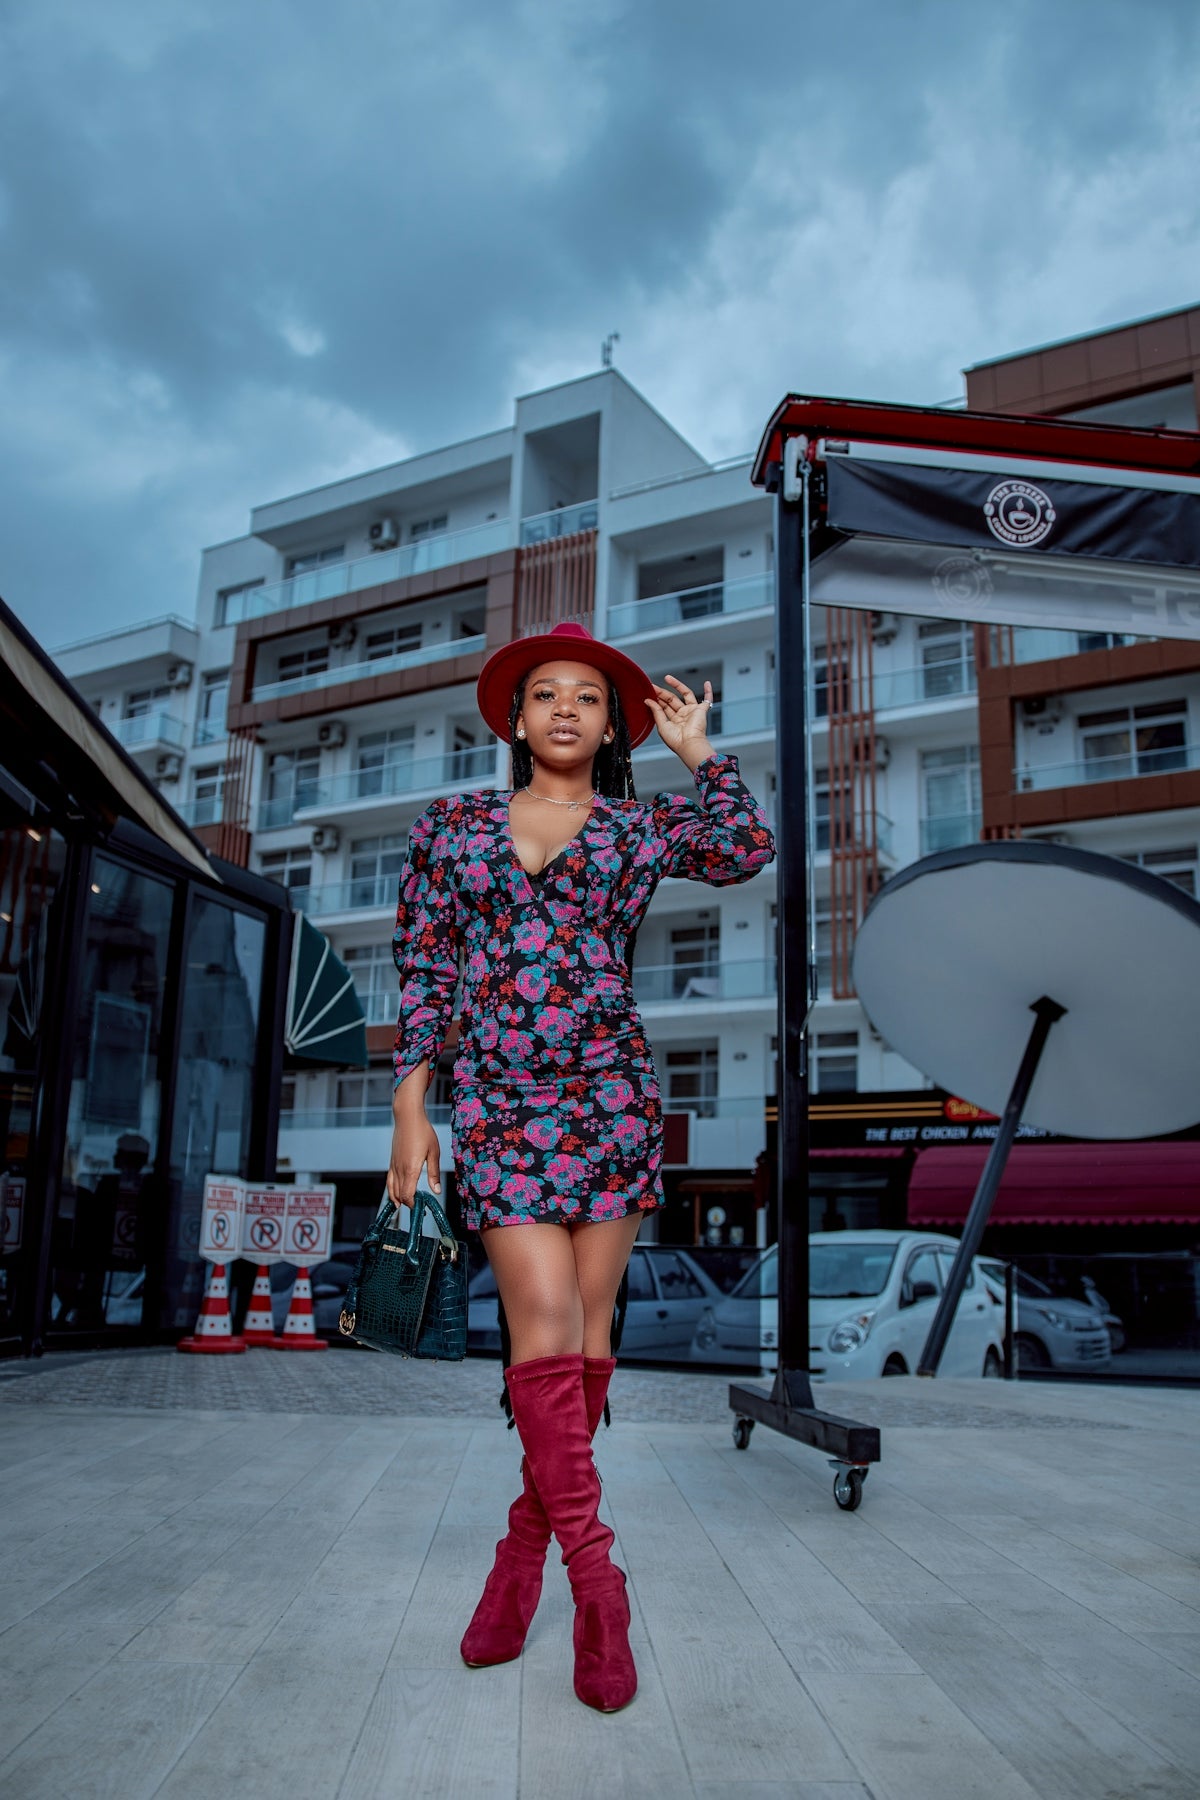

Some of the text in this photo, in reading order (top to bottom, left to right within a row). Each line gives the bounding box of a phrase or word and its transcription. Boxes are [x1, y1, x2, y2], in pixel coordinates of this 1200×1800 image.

[993, 484, 1046, 506] THE COFFEE
[992, 517, 1047, 542] CORNER LOUNGE
[865, 1127, 888, 1141] THE
[890, 1126, 919, 1141] BEST
[920, 1126, 969, 1139] CHICKEN
